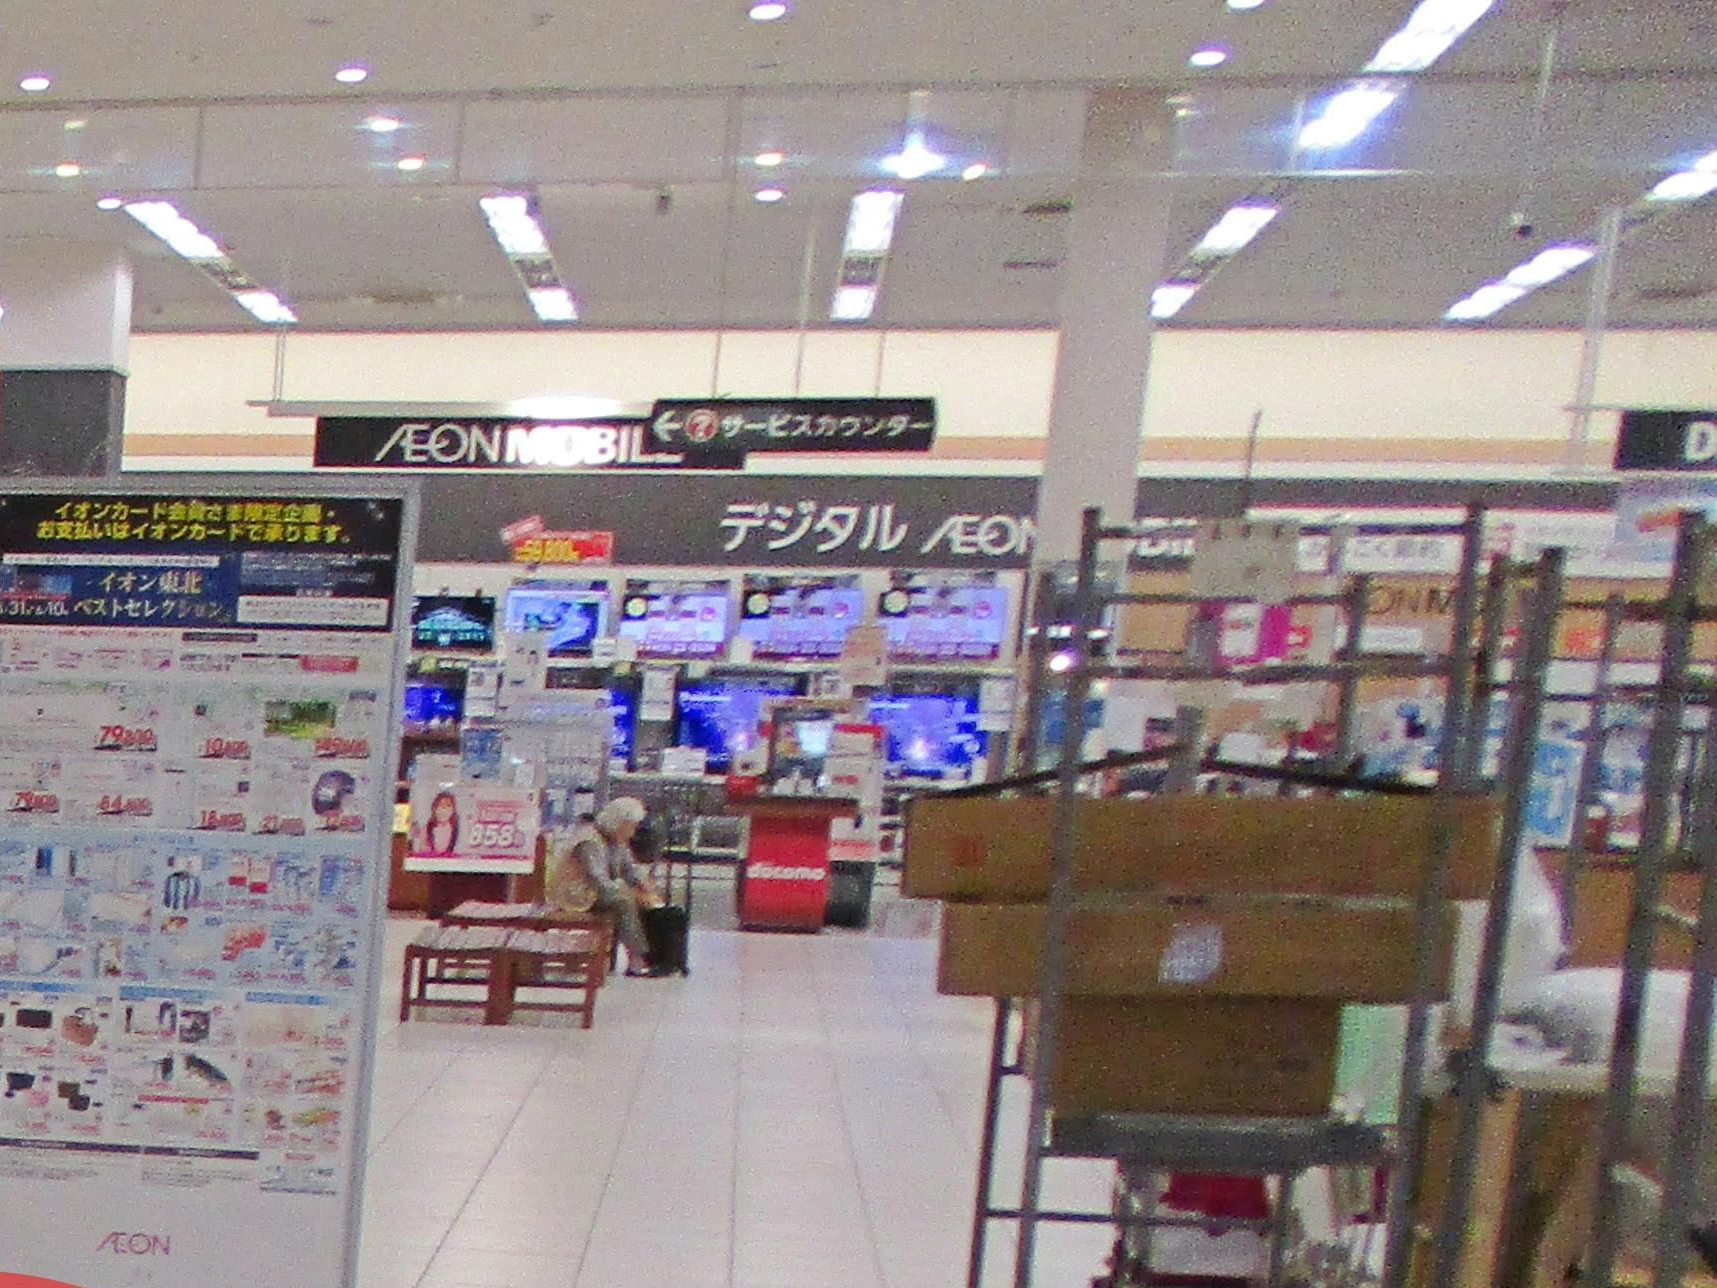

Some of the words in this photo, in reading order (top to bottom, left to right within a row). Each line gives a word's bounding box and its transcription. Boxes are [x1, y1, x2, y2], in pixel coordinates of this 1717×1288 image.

[719, 411, 932, 439] サービスカウンター
[719, 500, 910, 554] デジタル
